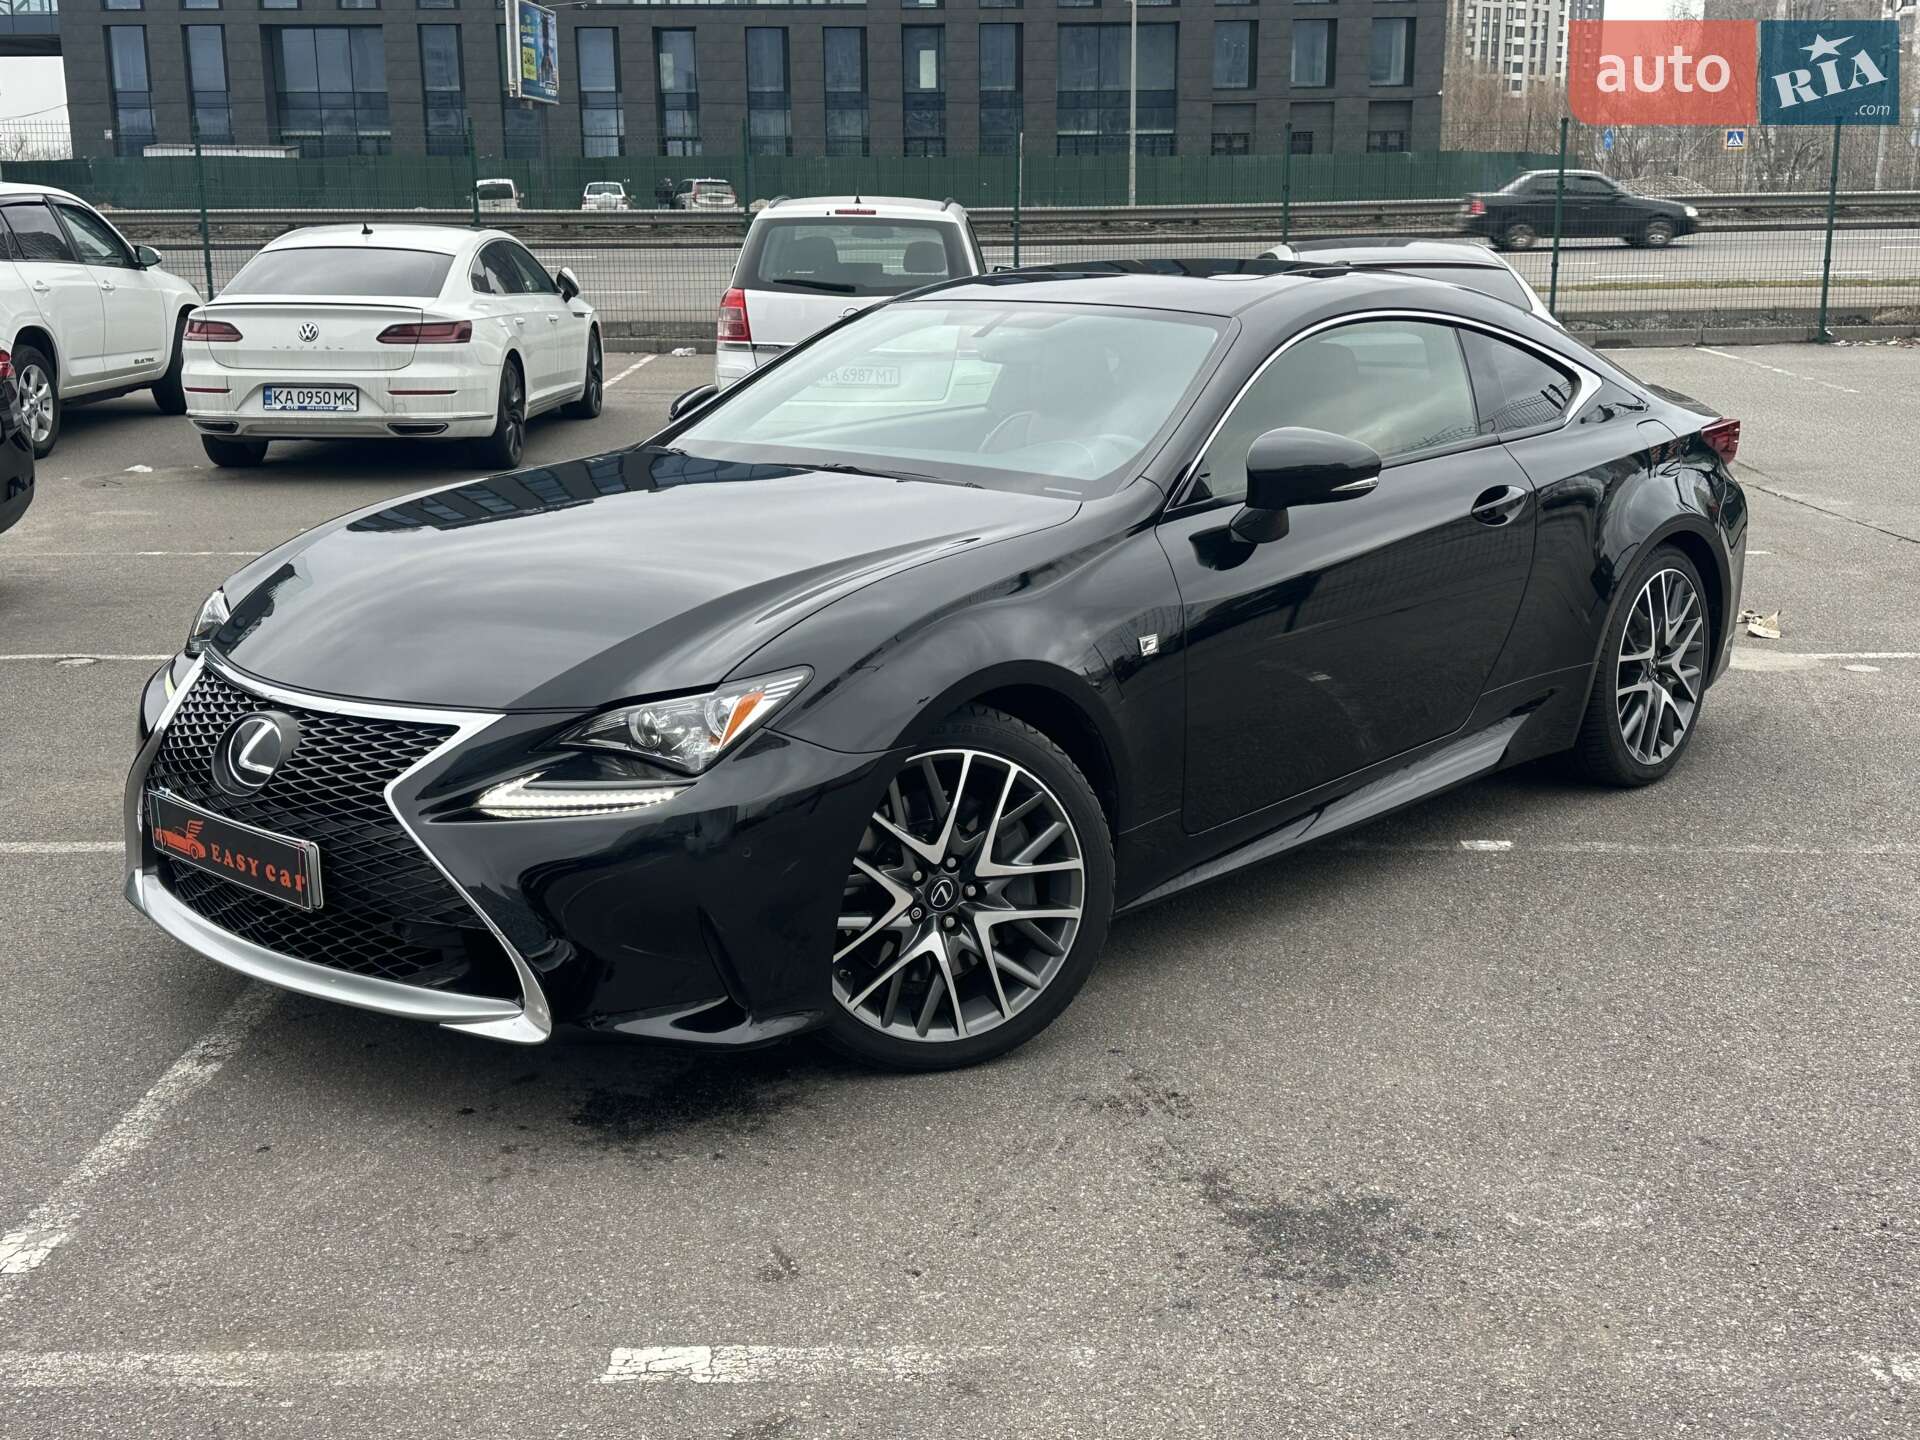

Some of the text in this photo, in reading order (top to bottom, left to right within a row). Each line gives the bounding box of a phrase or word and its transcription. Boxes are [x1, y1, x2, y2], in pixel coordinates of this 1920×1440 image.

[842, 368, 873, 382] 6987
[876, 369, 896, 383] MT
[273, 390, 354, 406] KA 0950 MK
[210, 843, 306, 892] EASY car
